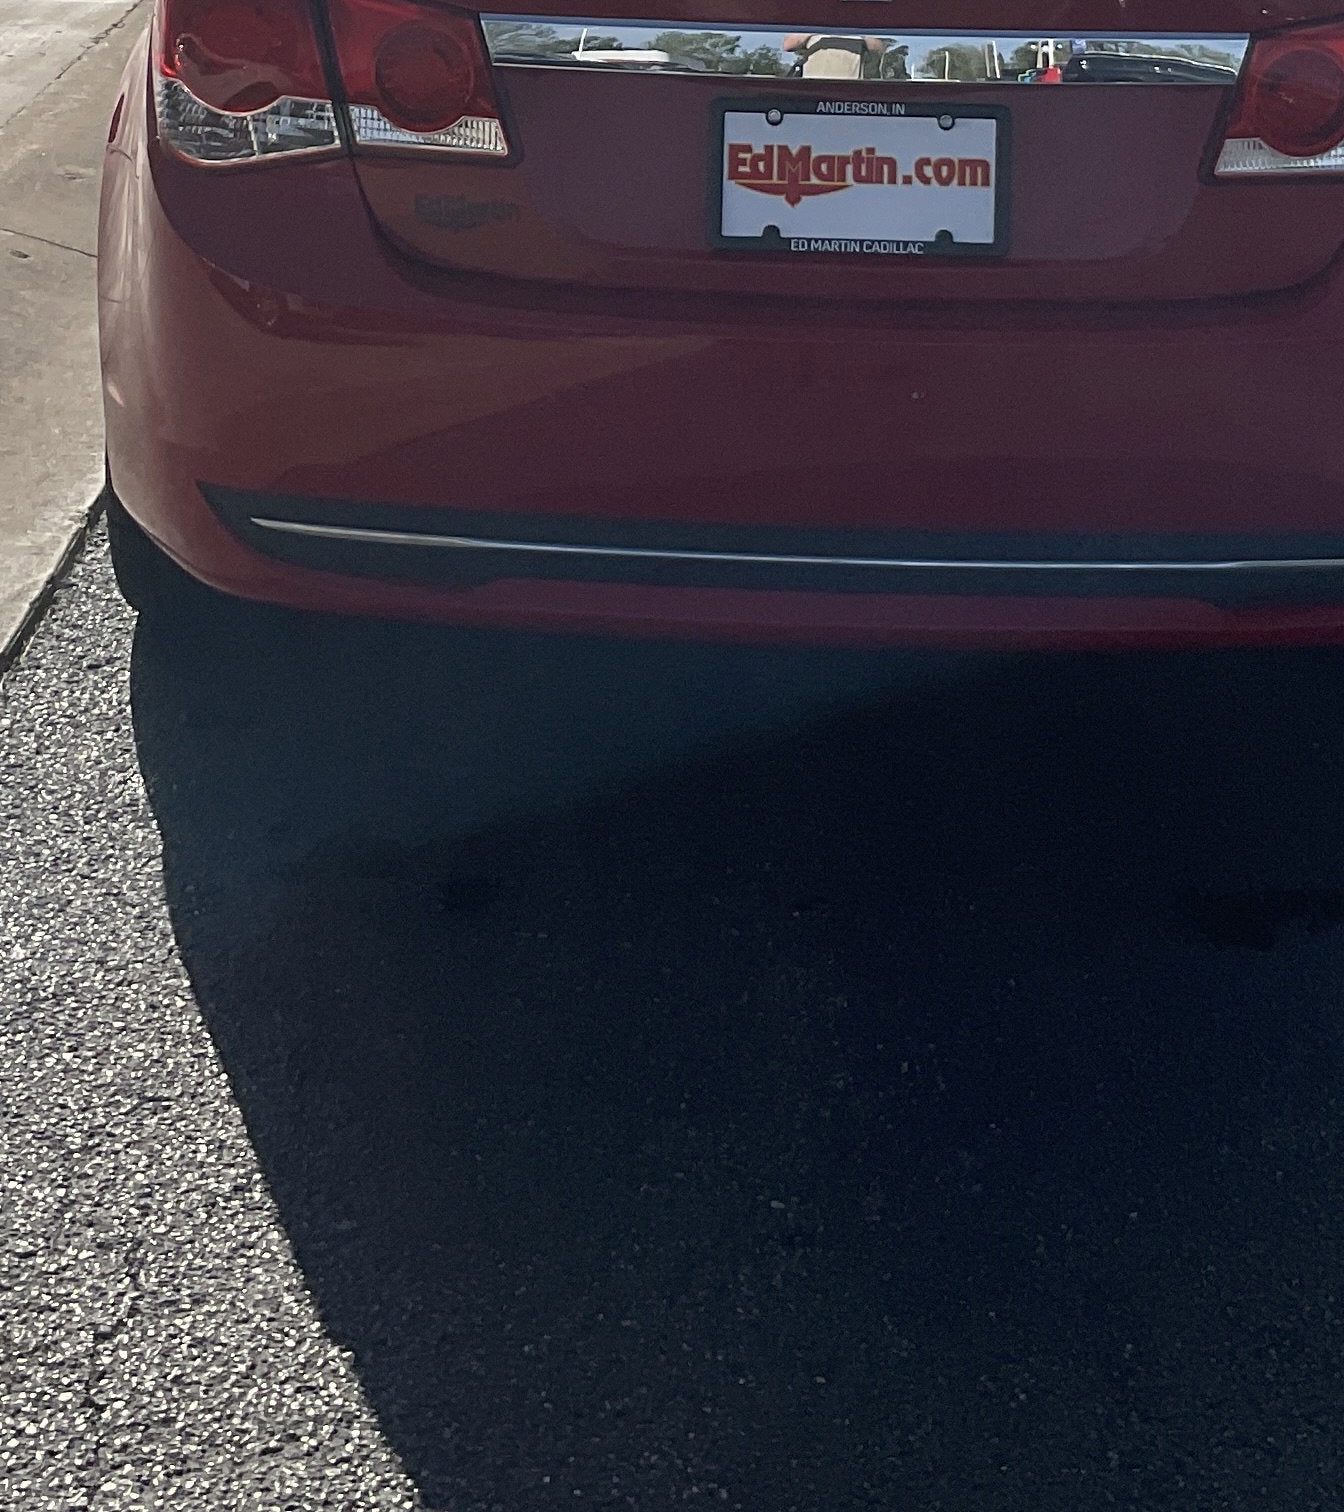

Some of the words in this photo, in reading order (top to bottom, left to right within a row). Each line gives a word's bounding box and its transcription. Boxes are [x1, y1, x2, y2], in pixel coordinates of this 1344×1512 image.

[892, 103, 906, 116] IN
[727, 142, 991, 188] EdMartin.com
[790, 238, 807, 252] ED
[810, 239, 860, 253] MARTIN
[862, 241, 925, 255] CADILLAC
